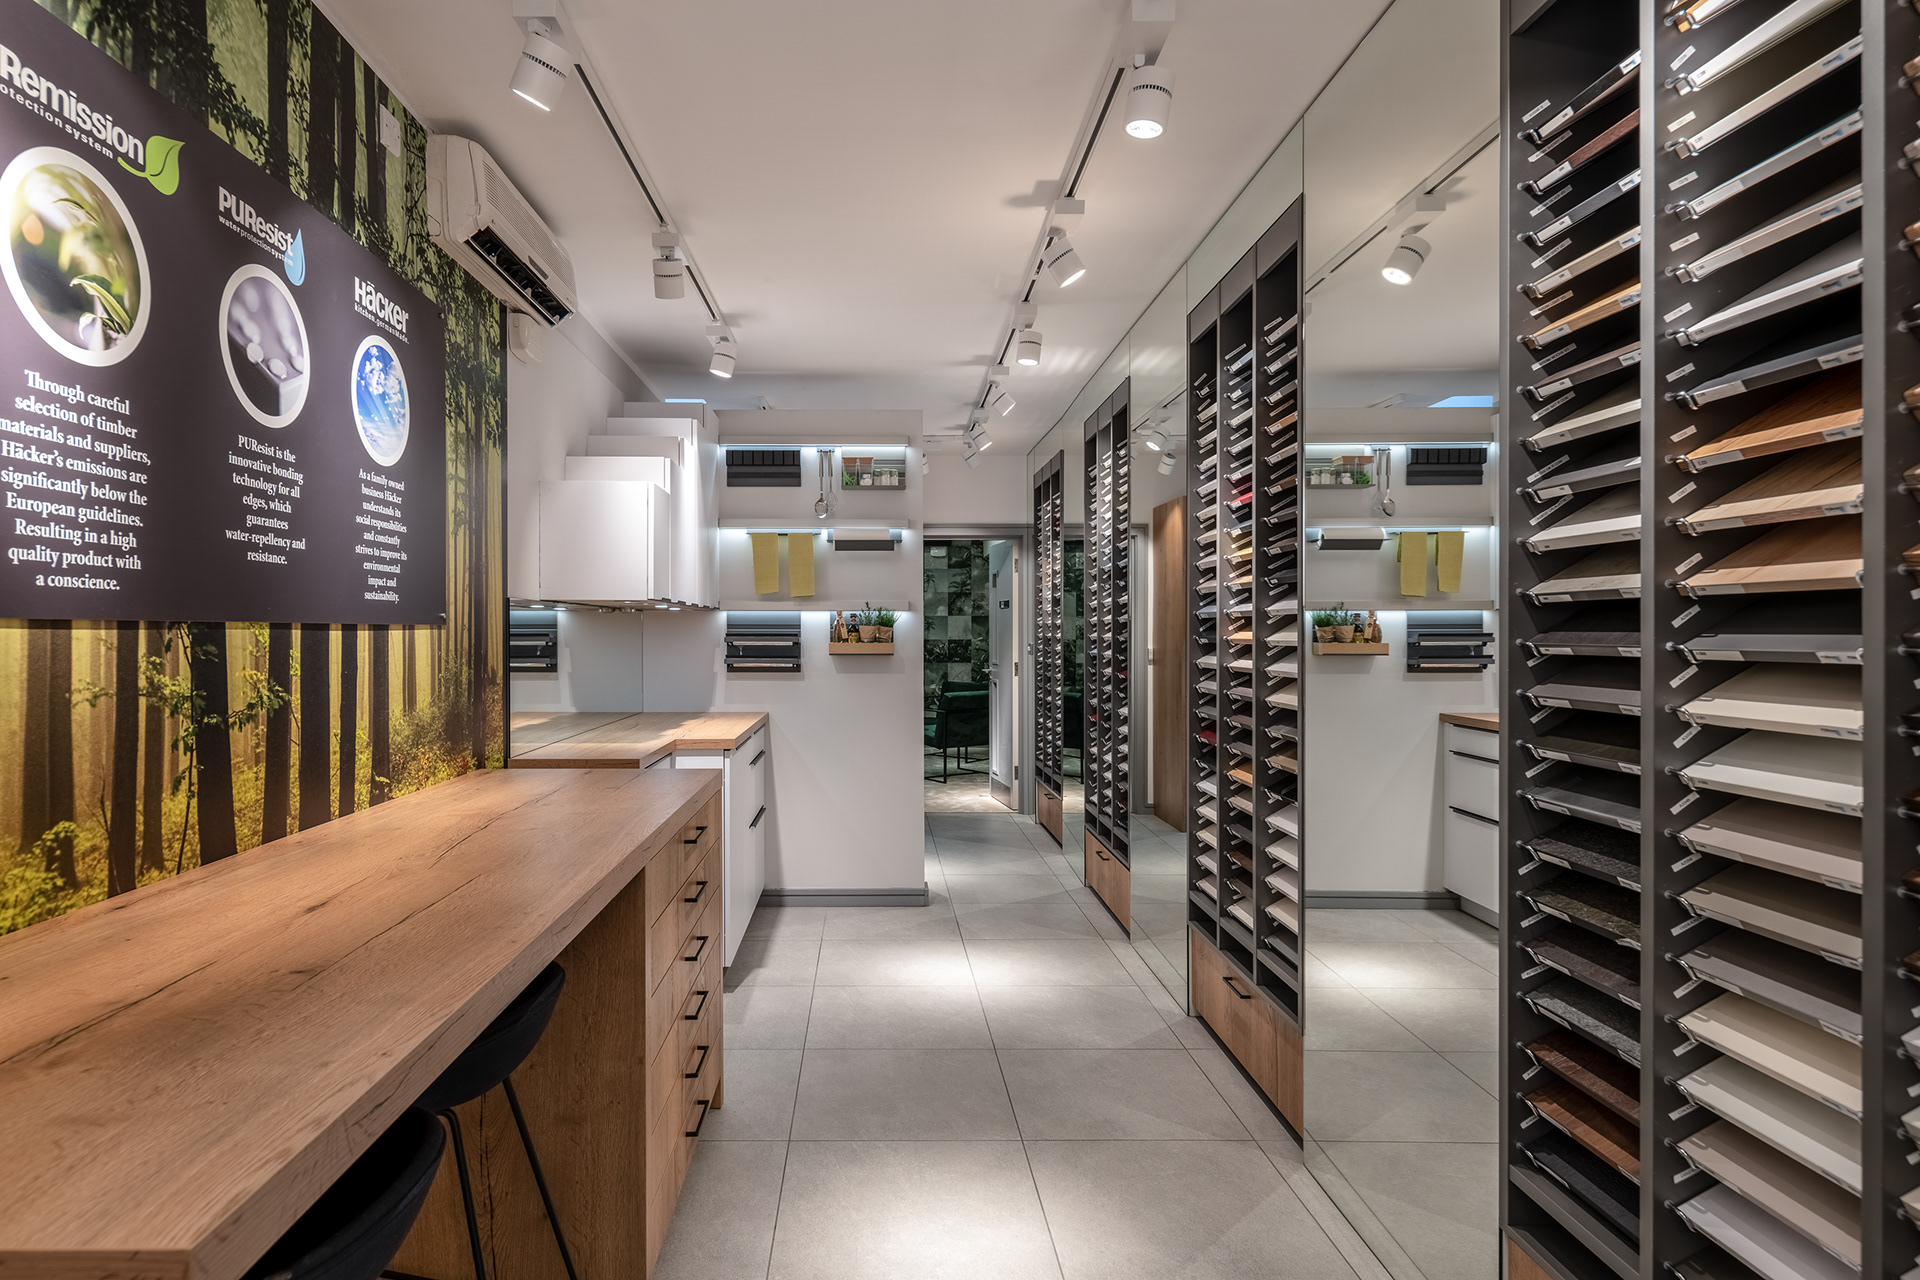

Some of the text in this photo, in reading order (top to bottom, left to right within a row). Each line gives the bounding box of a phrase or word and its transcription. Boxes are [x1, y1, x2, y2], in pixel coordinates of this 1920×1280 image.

[0, 44, 144, 165] Remission
[65, 124, 114, 160] system
[218, 185, 294, 257] PUResist
[24, 369, 130, 415] Through careful
[15, 396, 137, 439] selection of timber
[0, 418, 151, 466] materials and suppliers,
[238, 434, 296, 463] PUResist is the
[66, 456, 127, 480] emissions
[129, 470, 148, 484] are
[228, 451, 304, 485] innovative bonding
[358, 468, 405, 491] As a family owned
[1, 466, 148, 506] significantly below the
[232, 472, 300, 499] technology for all
[361, 484, 402, 505] business Häcker
[6, 492, 144, 527] European guidelines.
[243, 494, 292, 514] edges, which
[362, 501, 394, 517] understands
[246, 514, 289, 530] guarantees
[355, 514, 407, 534] social responsibilities
[15, 518, 137, 551] Resulting in a high
[225, 529, 306, 551] water-repellency and
[363, 531, 401, 549] and constantly
[8, 544, 142, 570] quality product with
[247, 551, 287, 565] resistance.
[355, 544, 373, 555] strives
[373, 548, 380, 556] to
[379, 547, 401, 561] improve
[363, 560, 401, 574] environmental
[35, 573, 120, 591] a conscience.
[367, 575, 397, 588] impact and
[364, 590, 400, 604] sustainability.
